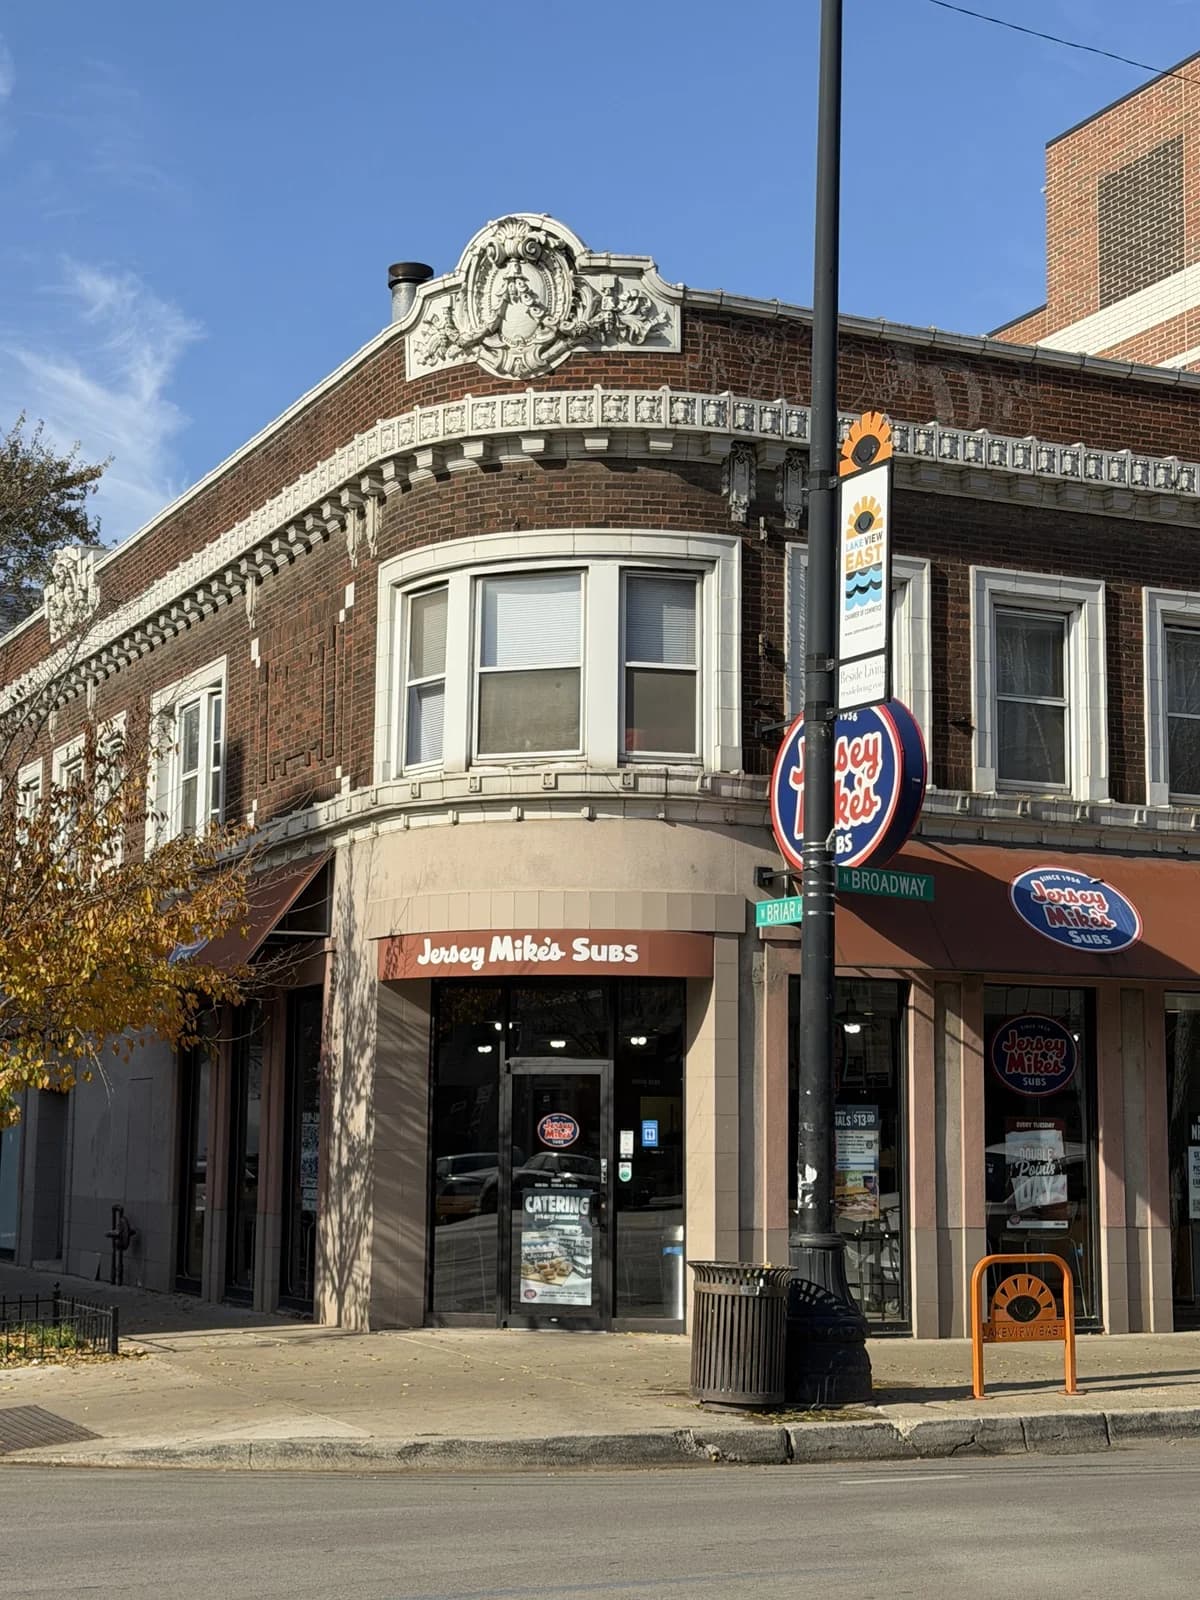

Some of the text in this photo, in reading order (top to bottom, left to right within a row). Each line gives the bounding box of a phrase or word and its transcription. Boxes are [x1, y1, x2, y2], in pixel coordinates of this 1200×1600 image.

[845, 530, 882, 552] LAKE VIEW
[845, 543, 882, 572] EAST
[835, 833, 853, 854] BS
[843, 871, 926, 897] N BROADWAY
[1031, 880, 1108, 912] Jersey
[767, 901, 795, 921] BRIAR
[1043, 904, 1117, 930] Mike's
[1068, 930, 1112, 945] SUBS
[417, 935, 639, 971] Jersey Mike's SUBS
[1002, 1030, 1067, 1060] Jersey
[1005, 1050, 1066, 1076] Mike's
[1022, 1077, 1047, 1087] SUBS
[543, 1118, 575, 1132] Jersey
[1016, 1121, 1056, 1129] EVERY TUESDAY
[1019, 1146, 1054, 1162] DOUBLE
[1015, 1160, 1056, 1177] Points
[1019, 1175, 1054, 1206] DAY
[525, 1195, 590, 1215] CATERING
[1039, 1323, 1065, 1337] EAST
